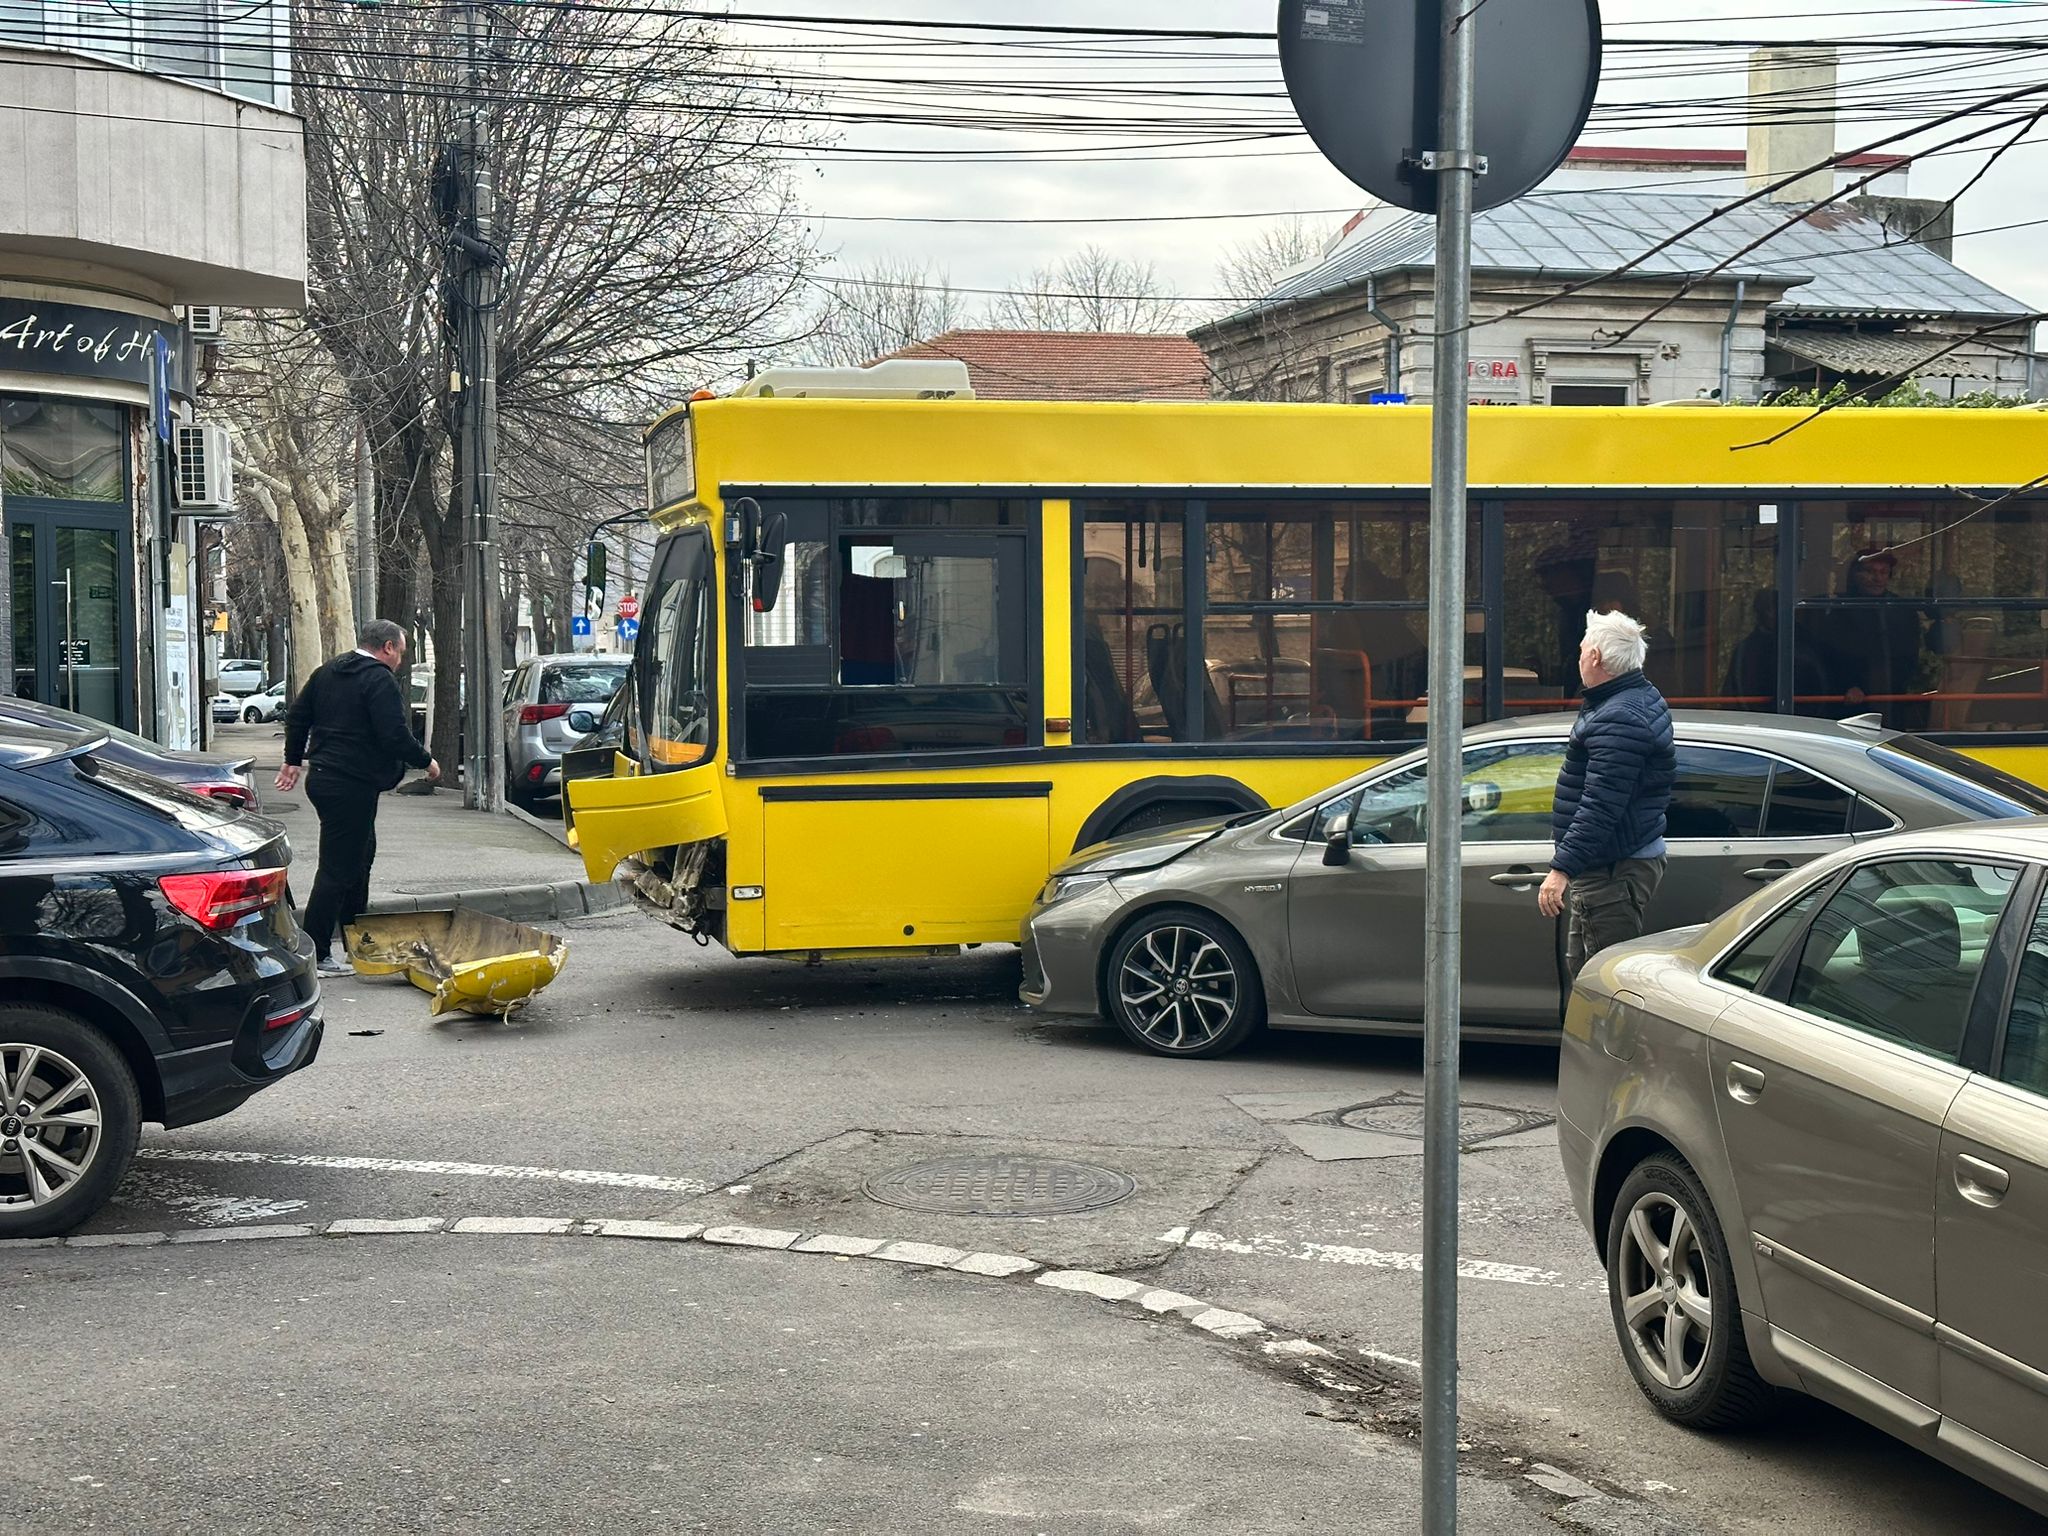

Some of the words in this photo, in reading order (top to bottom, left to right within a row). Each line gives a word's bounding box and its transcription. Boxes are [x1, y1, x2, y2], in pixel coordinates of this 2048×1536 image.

[0, 314, 74, 352] Art
[77, 327, 119, 363] of
[618, 602, 638, 612] STOP
